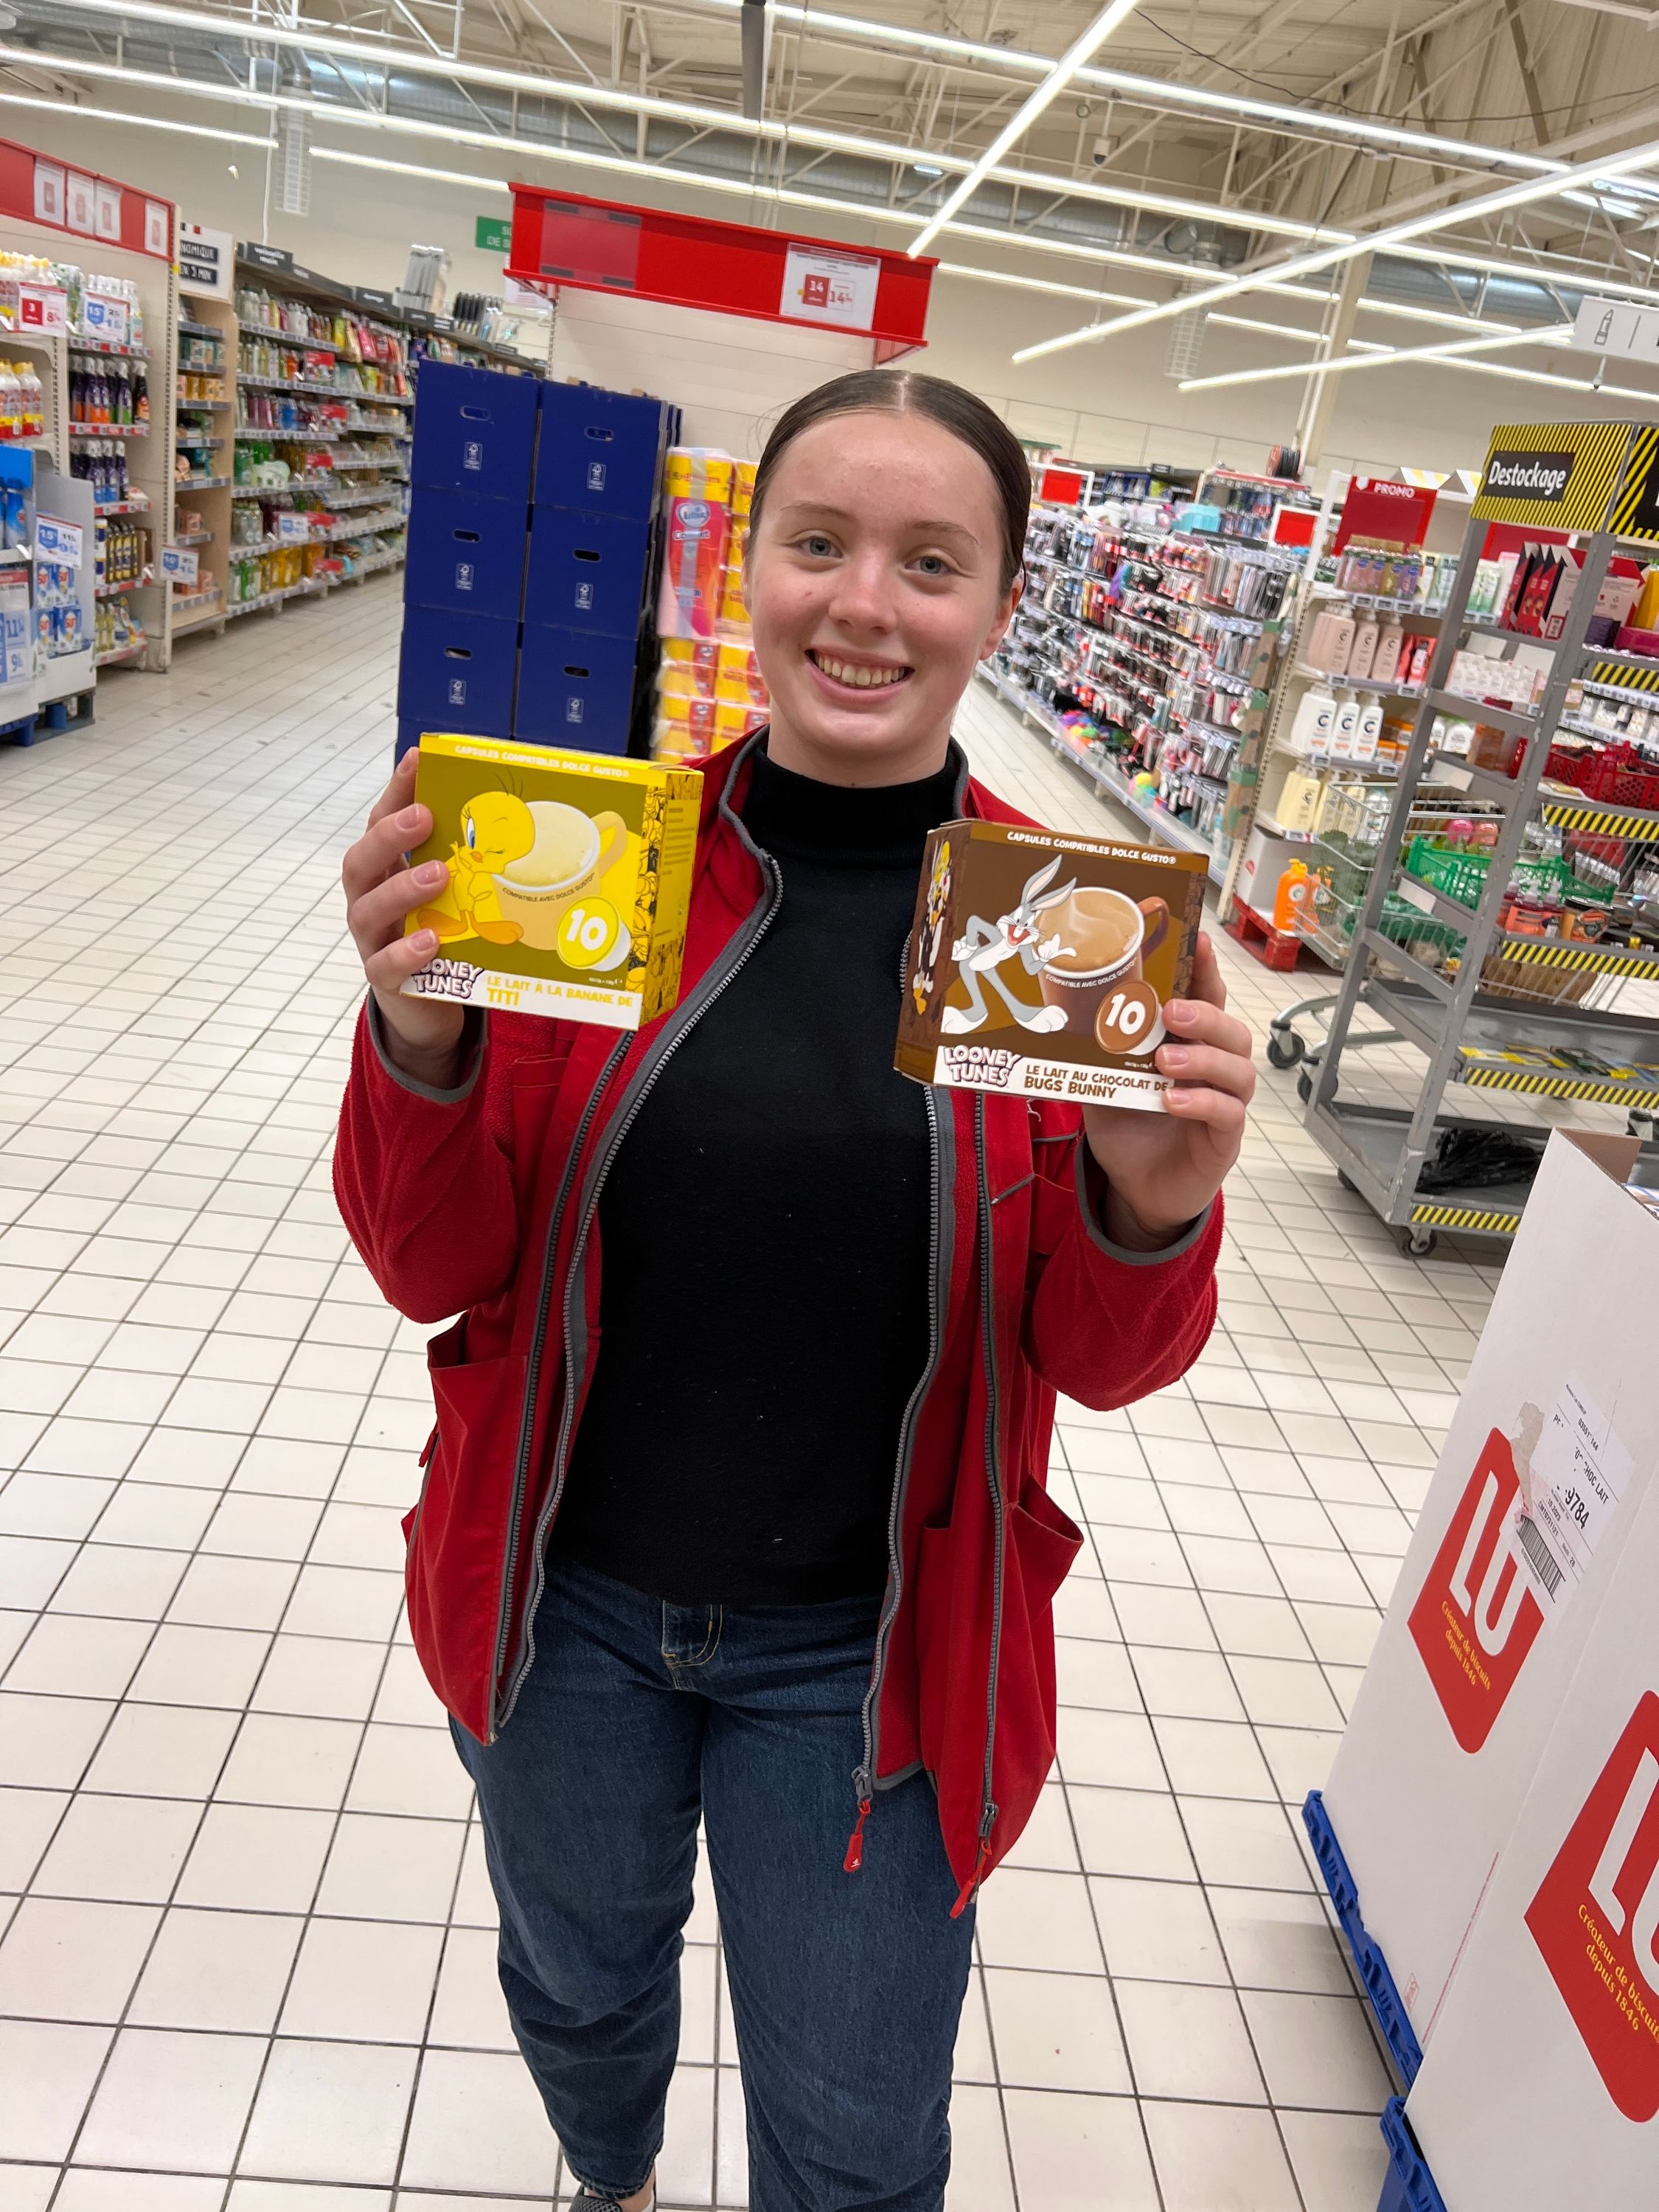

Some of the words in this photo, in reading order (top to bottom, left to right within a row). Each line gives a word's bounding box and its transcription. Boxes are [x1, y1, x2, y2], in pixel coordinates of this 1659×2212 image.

[1374, 481, 1415, 498] PROMO
[1488, 460, 1567, 495] Destockage
[455, 745, 498, 759] CAPSULES
[502, 751, 560, 768] COMPATIBLES
[563, 761, 590, 773] DOLCE
[1007, 831, 1051, 846] CAPSULES
[1053, 838, 1110, 855] COMPATIBLES
[1112, 847, 1138, 859] DOLCE
[502, 887, 538, 902] COMPATIBLE
[556, 888, 575, 900] DOLCE
[566, 908, 608, 950] 10
[419, 958, 484, 983] ONEY
[1046, 973, 1080, 988] COMPATIBLE
[1098, 974, 1117, 985] DOLCE
[413, 973, 473, 999] TUNES
[487, 975, 501, 987] LE
[506, 978, 531, 992] LAIT
[535, 981, 543, 992] À
[548, 985, 562, 996] LA
[566, 989, 614, 1004] BANANE
[618, 997, 633, 1007] DE
[487, 988, 520, 1006] TITI
[1105, 993, 1146, 1034] 10
[943, 1044, 1023, 1070] LOONEY
[950, 1064, 1010, 1088] TUNES
[1023, 1076, 1062, 1092] BUGS
[1068, 1082, 1117, 1099] BUNNY
[1026, 1065, 1040, 1076] LE
[1043, 1068, 1068, 1079] LAIT
[1072, 1071, 1088, 1082] AU
[1092, 1073, 1150, 1090] CHOCOLAT
[1154, 1082, 1169, 1092] DE
[1595, 1483, 1609, 1504] LAIT
[1449, 1470, 1534, 1656] LU
[1442, 1601, 1464, 1641] Créateur
[1462, 1639, 1471, 1655] de
[1470, 1649, 1491, 1690] biscuits
[1446, 1630, 1462, 1662] depuis
[1462, 1658, 1476, 1686] 1846
[1578, 1904, 1615, 1965] Créateur
[1615, 1966, 1628, 1986] de
[1587, 1944, 1615, 1993] depuis
[1615, 1989, 1639, 2031] 1846
